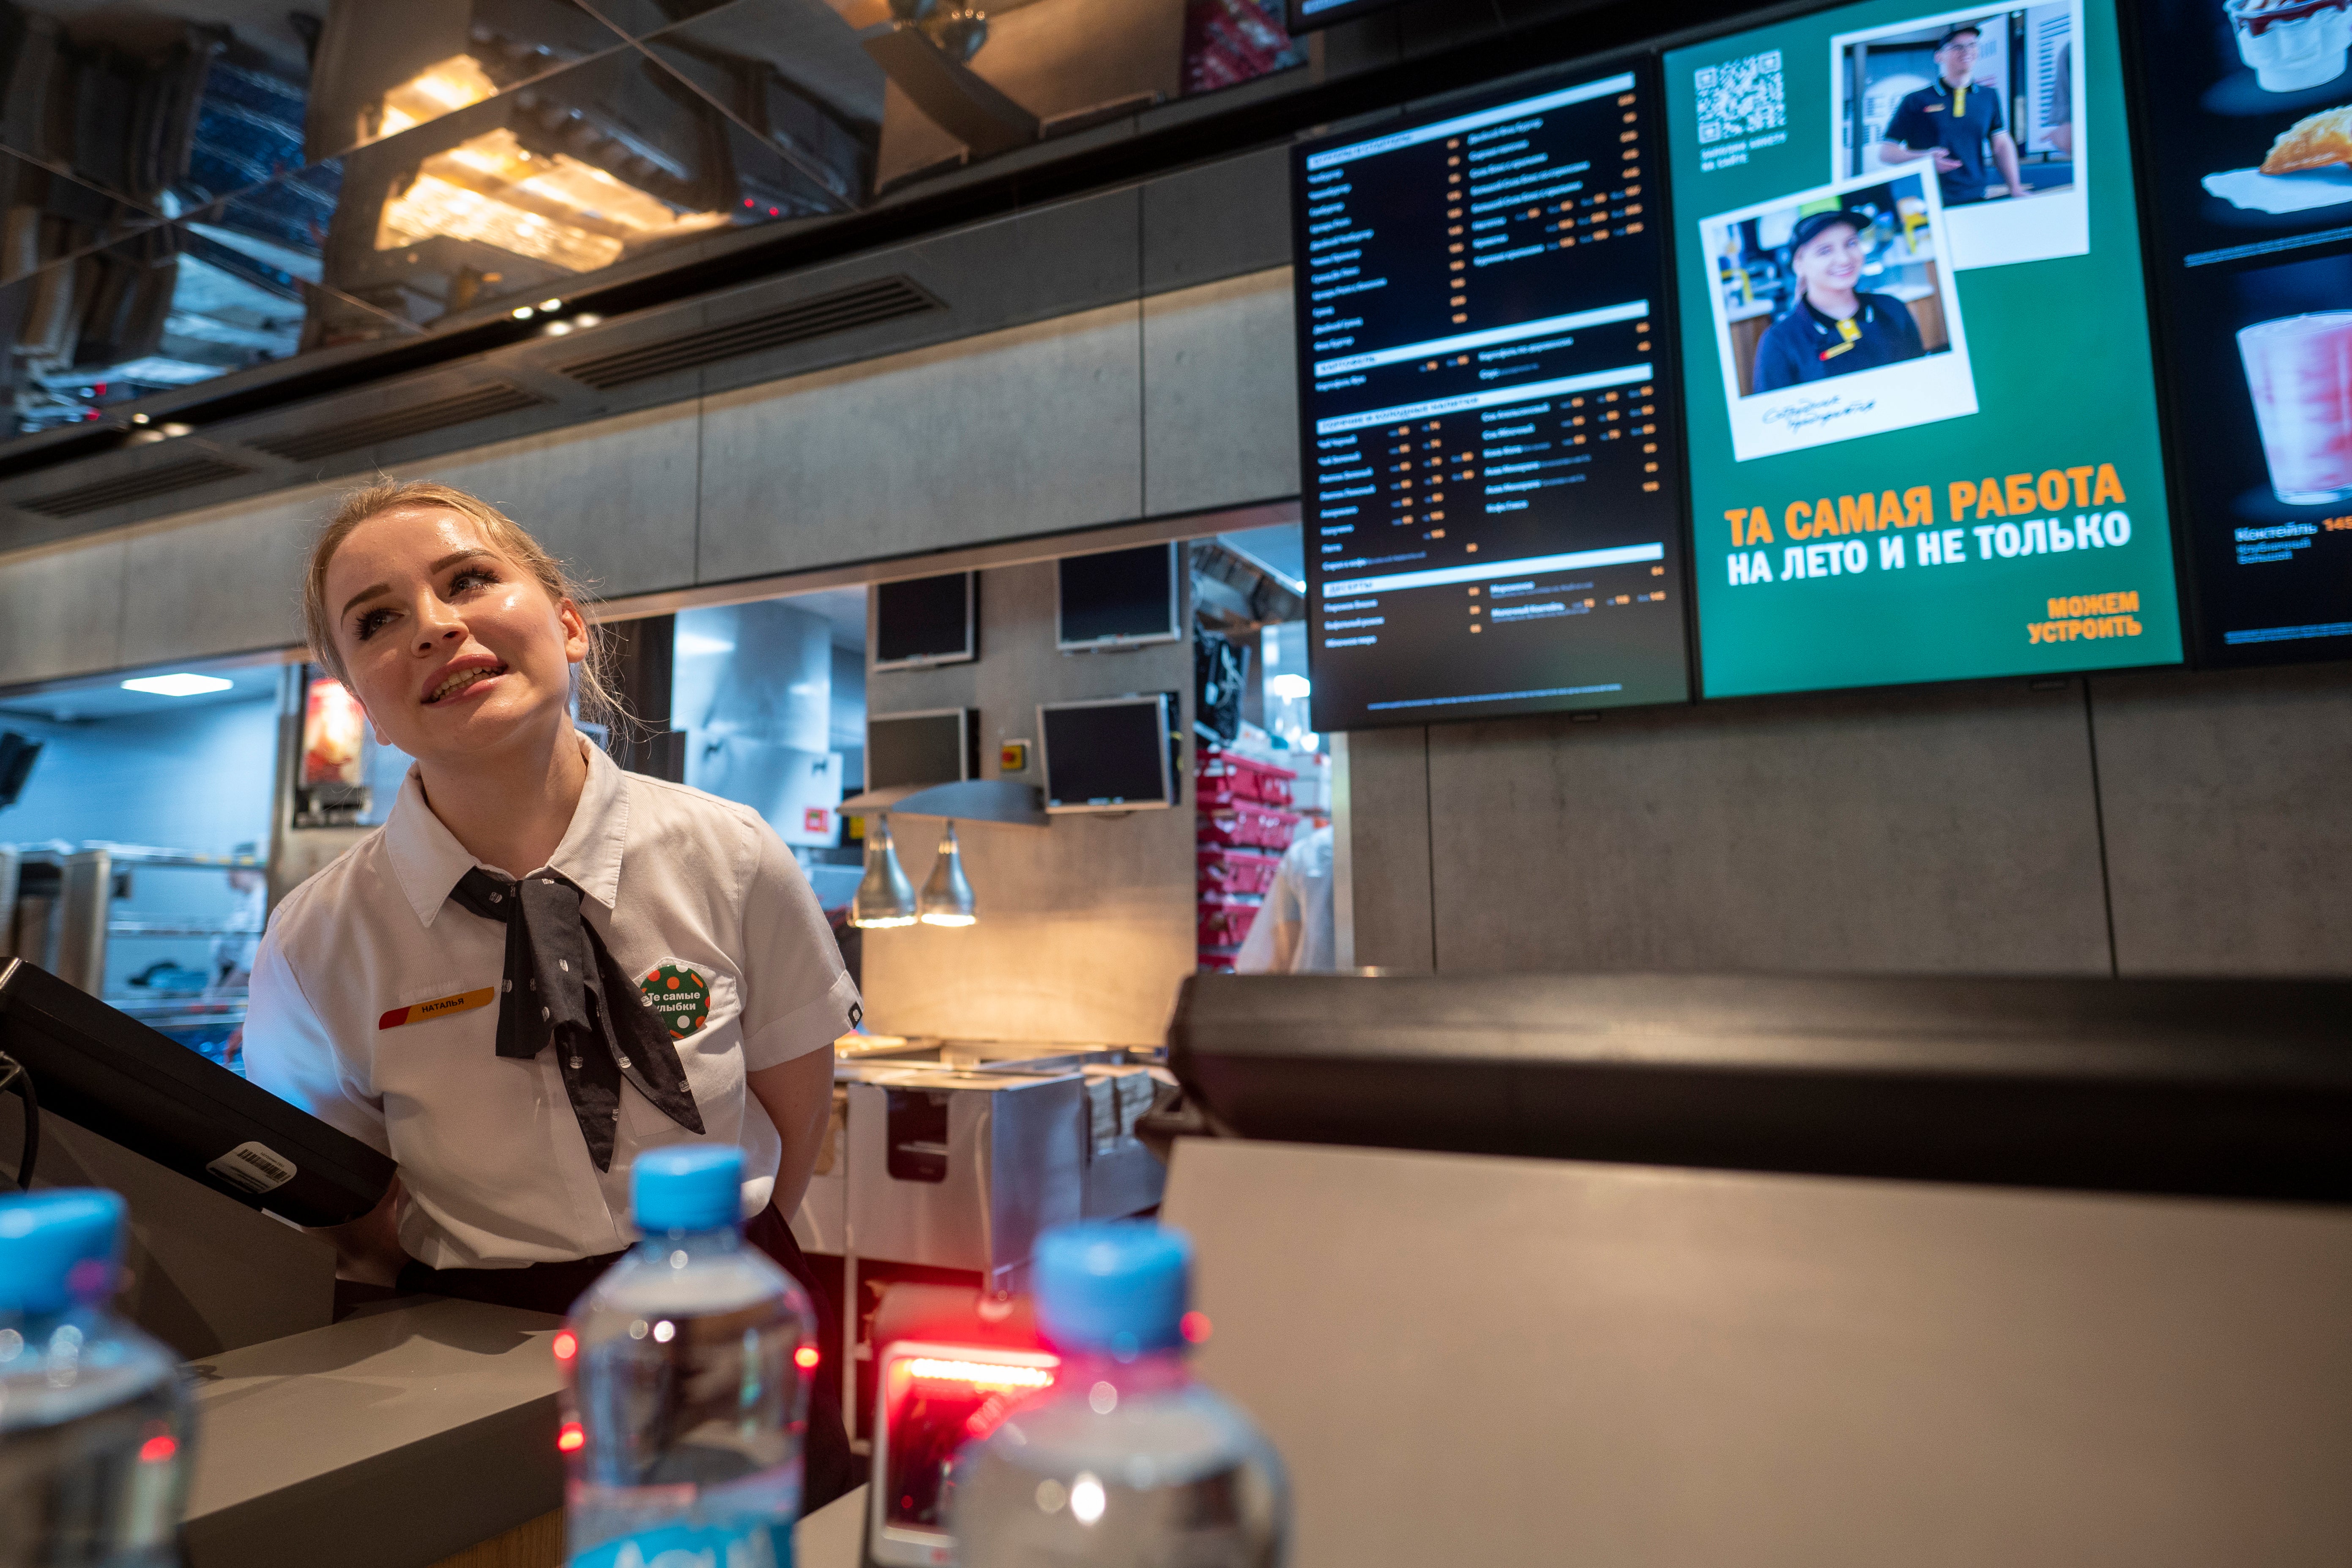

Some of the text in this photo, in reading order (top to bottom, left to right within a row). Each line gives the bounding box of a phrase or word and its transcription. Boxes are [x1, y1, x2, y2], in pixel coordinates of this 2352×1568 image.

[1724, 463, 2126, 547] ТА САМАЯ РАБОТА
[2234, 522, 2319, 542] Коктейль
[1727, 510, 2131, 586] НА ЛЕТО И НЕ ТОЛЬКО
[2047, 590, 2139, 619] МОЖЕМ
[2027, 615, 2143, 645] УСТРОИТЬ
[421, 997, 465, 1013] НАТАЛЬЯ
[648, 992, 700, 1001] Те самые
